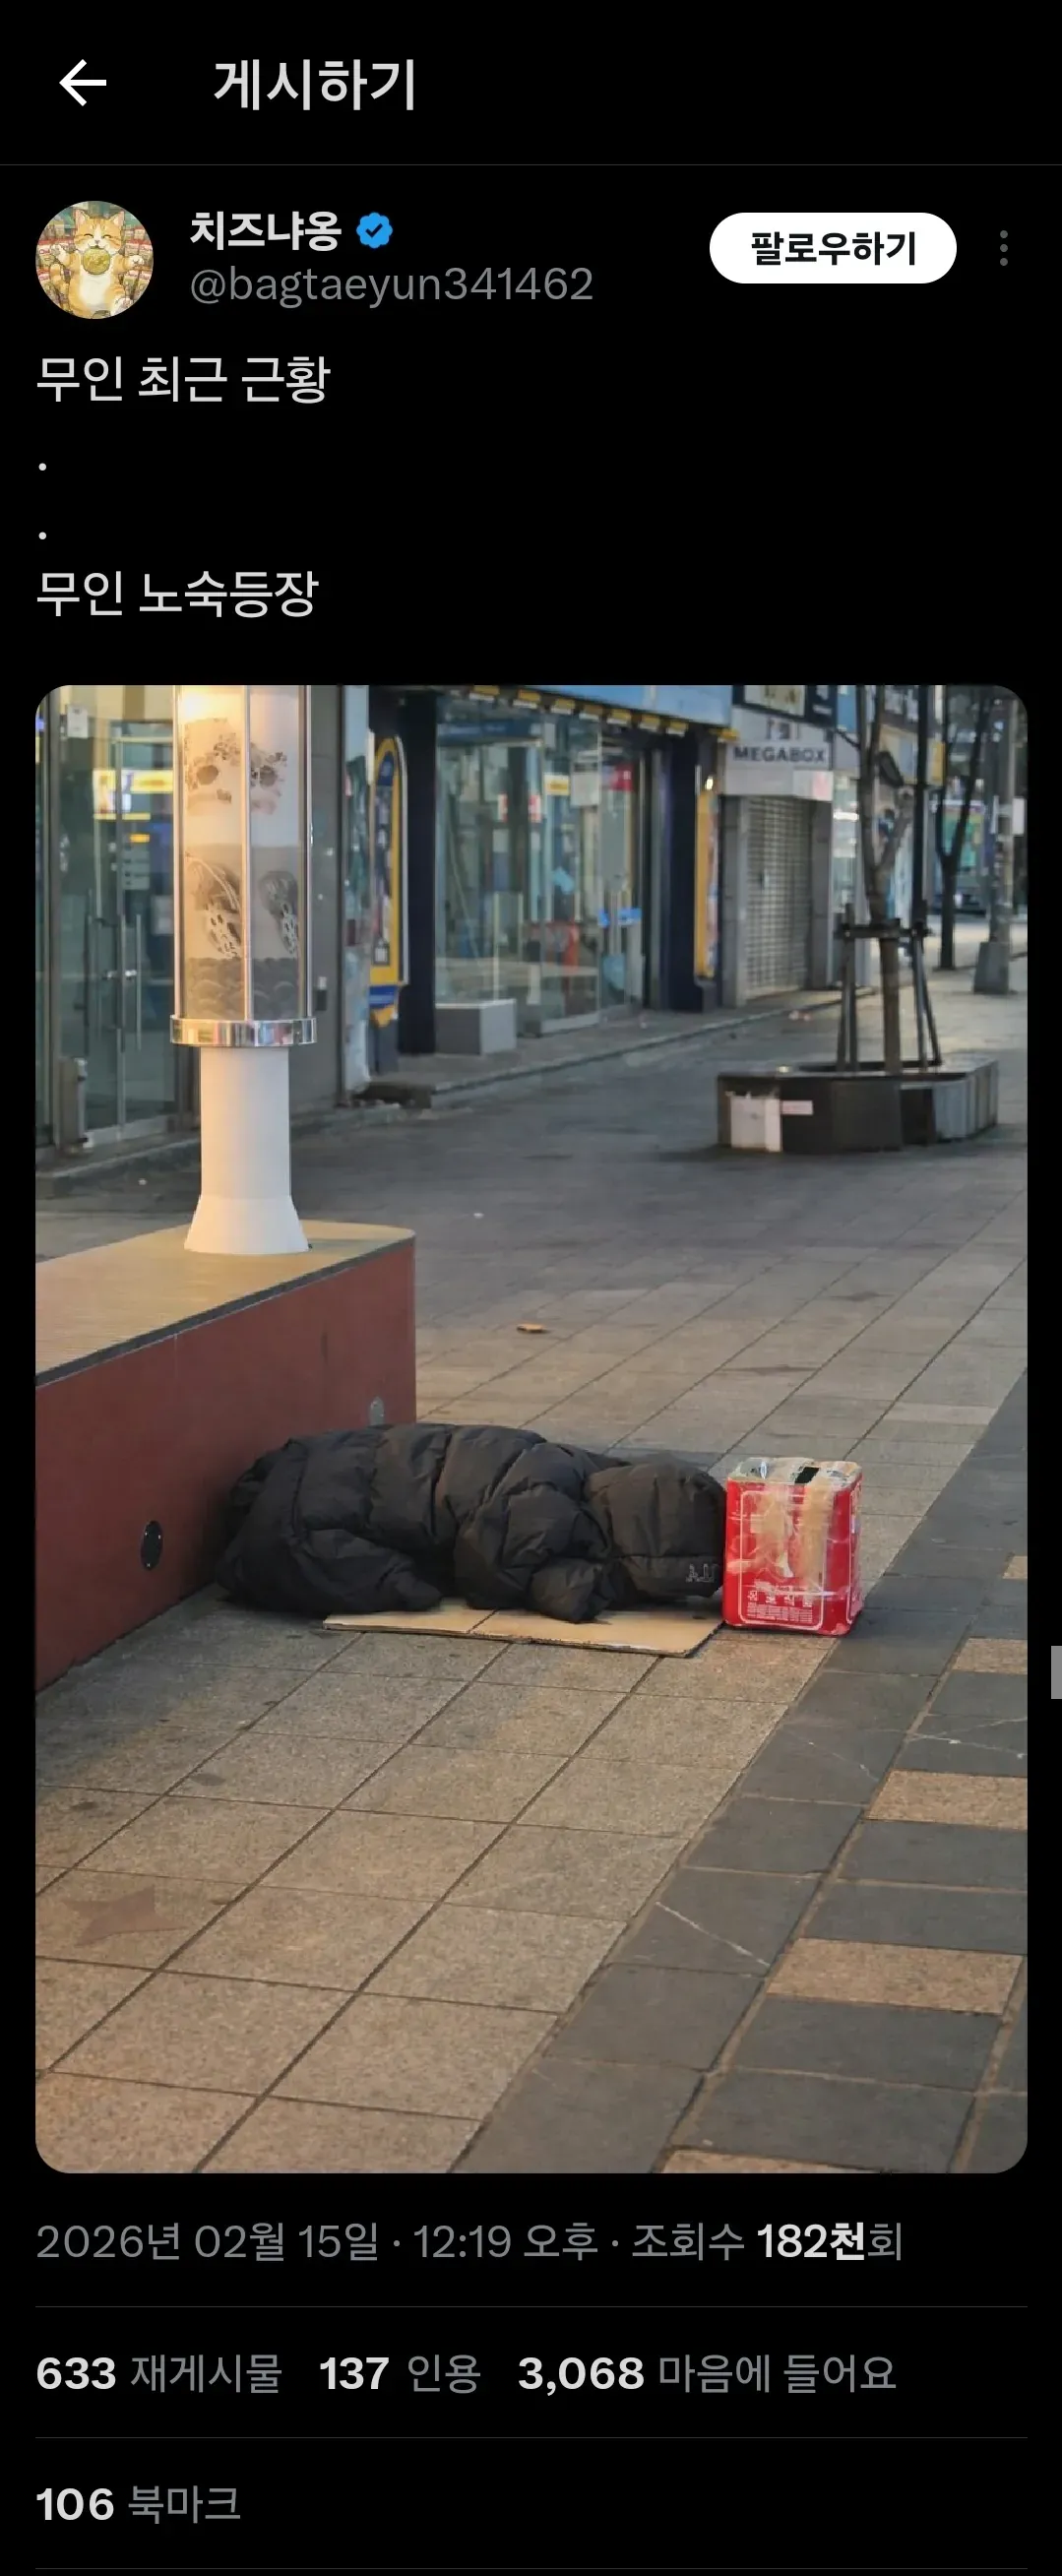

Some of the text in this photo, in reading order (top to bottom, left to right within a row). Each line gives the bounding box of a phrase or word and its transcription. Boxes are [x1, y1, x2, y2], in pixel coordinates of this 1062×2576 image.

[215, 59, 413, 110] 게시하기
[190, 211, 342, 251] 치즈냐옹
[751, 231, 915, 265] 팔로우하기
[191, 266, 593, 308] @bagtaeyun341462
[37, 356, 331, 404] 무인 최근 근황
[37, 571, 319, 618] 무인 노숙등장
[733, 746, 825, 763] MEGABOX
[37, 2223, 179, 2260] 2026년
[196, 2223, 283, 2261] 02월
[299, 2223, 377, 2260] 15일
[414, 2226, 511, 2257] 12:19
[524, 2223, 597, 2261] 오후
[632, 2223, 744, 2260] 조회수
[758, 2222, 901, 2260] 182천회
[37, 2355, 281, 2393] 633 재게시물
[320, 2355, 480, 2393] 137 인용
[519, 2355, 896, 2396] 3,068 마음에 들어요
[36, 2485, 240, 2524] 106 북마크
